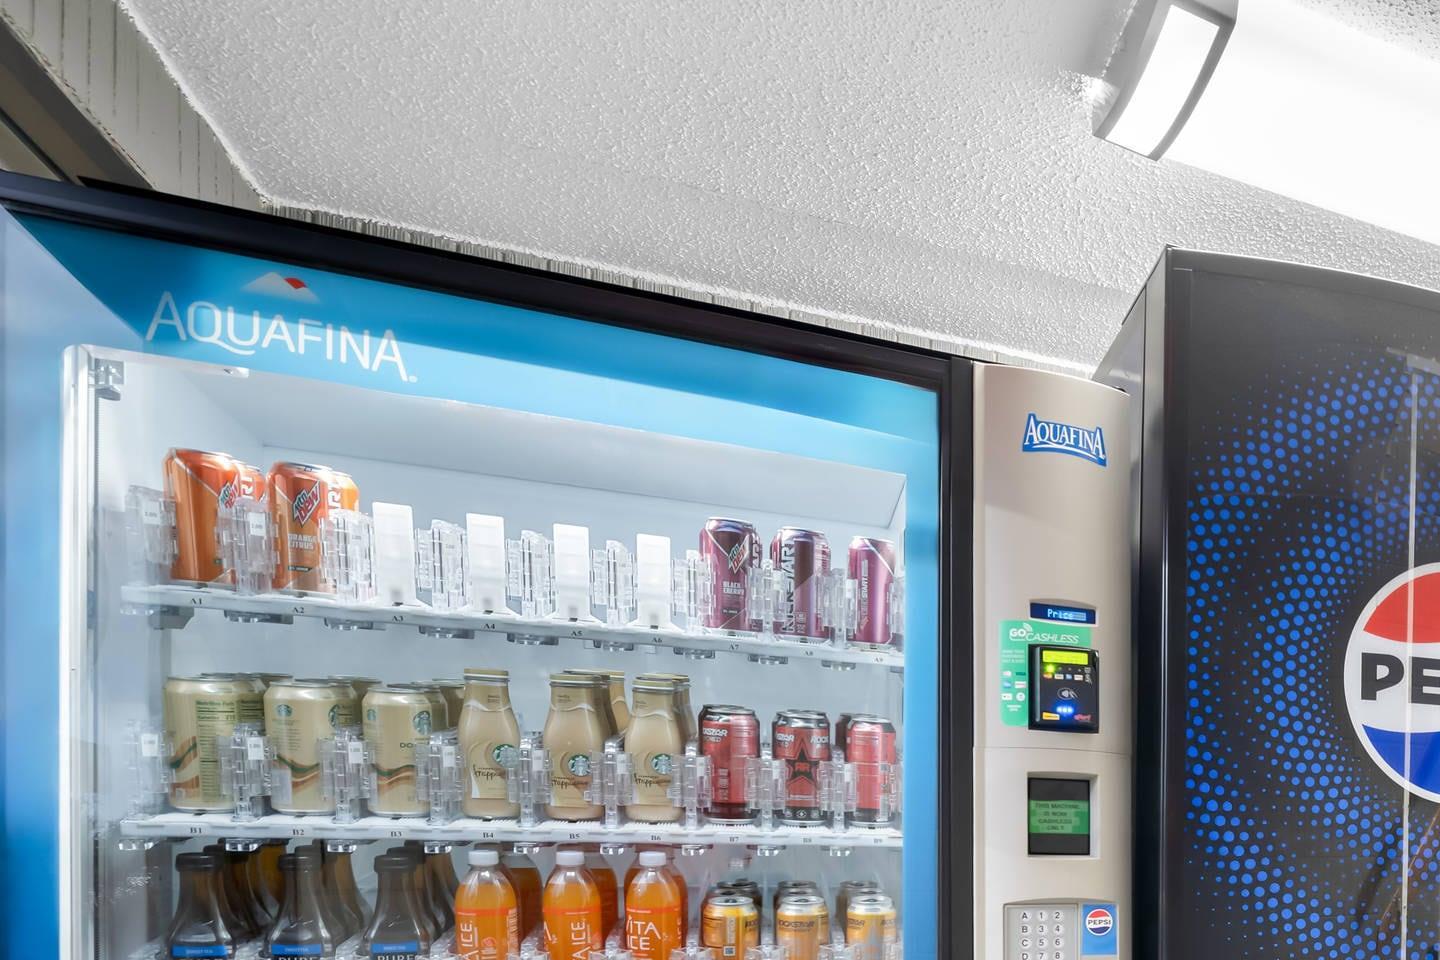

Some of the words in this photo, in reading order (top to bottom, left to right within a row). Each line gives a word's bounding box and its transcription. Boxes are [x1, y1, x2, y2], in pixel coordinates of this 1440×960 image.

[145, 290, 412, 383] AQUAFINA
[1023, 415, 1106, 461] AQUAFINA
[1009, 628, 1027, 638] GO
[1025, 633, 1080, 644] CASHLESS
